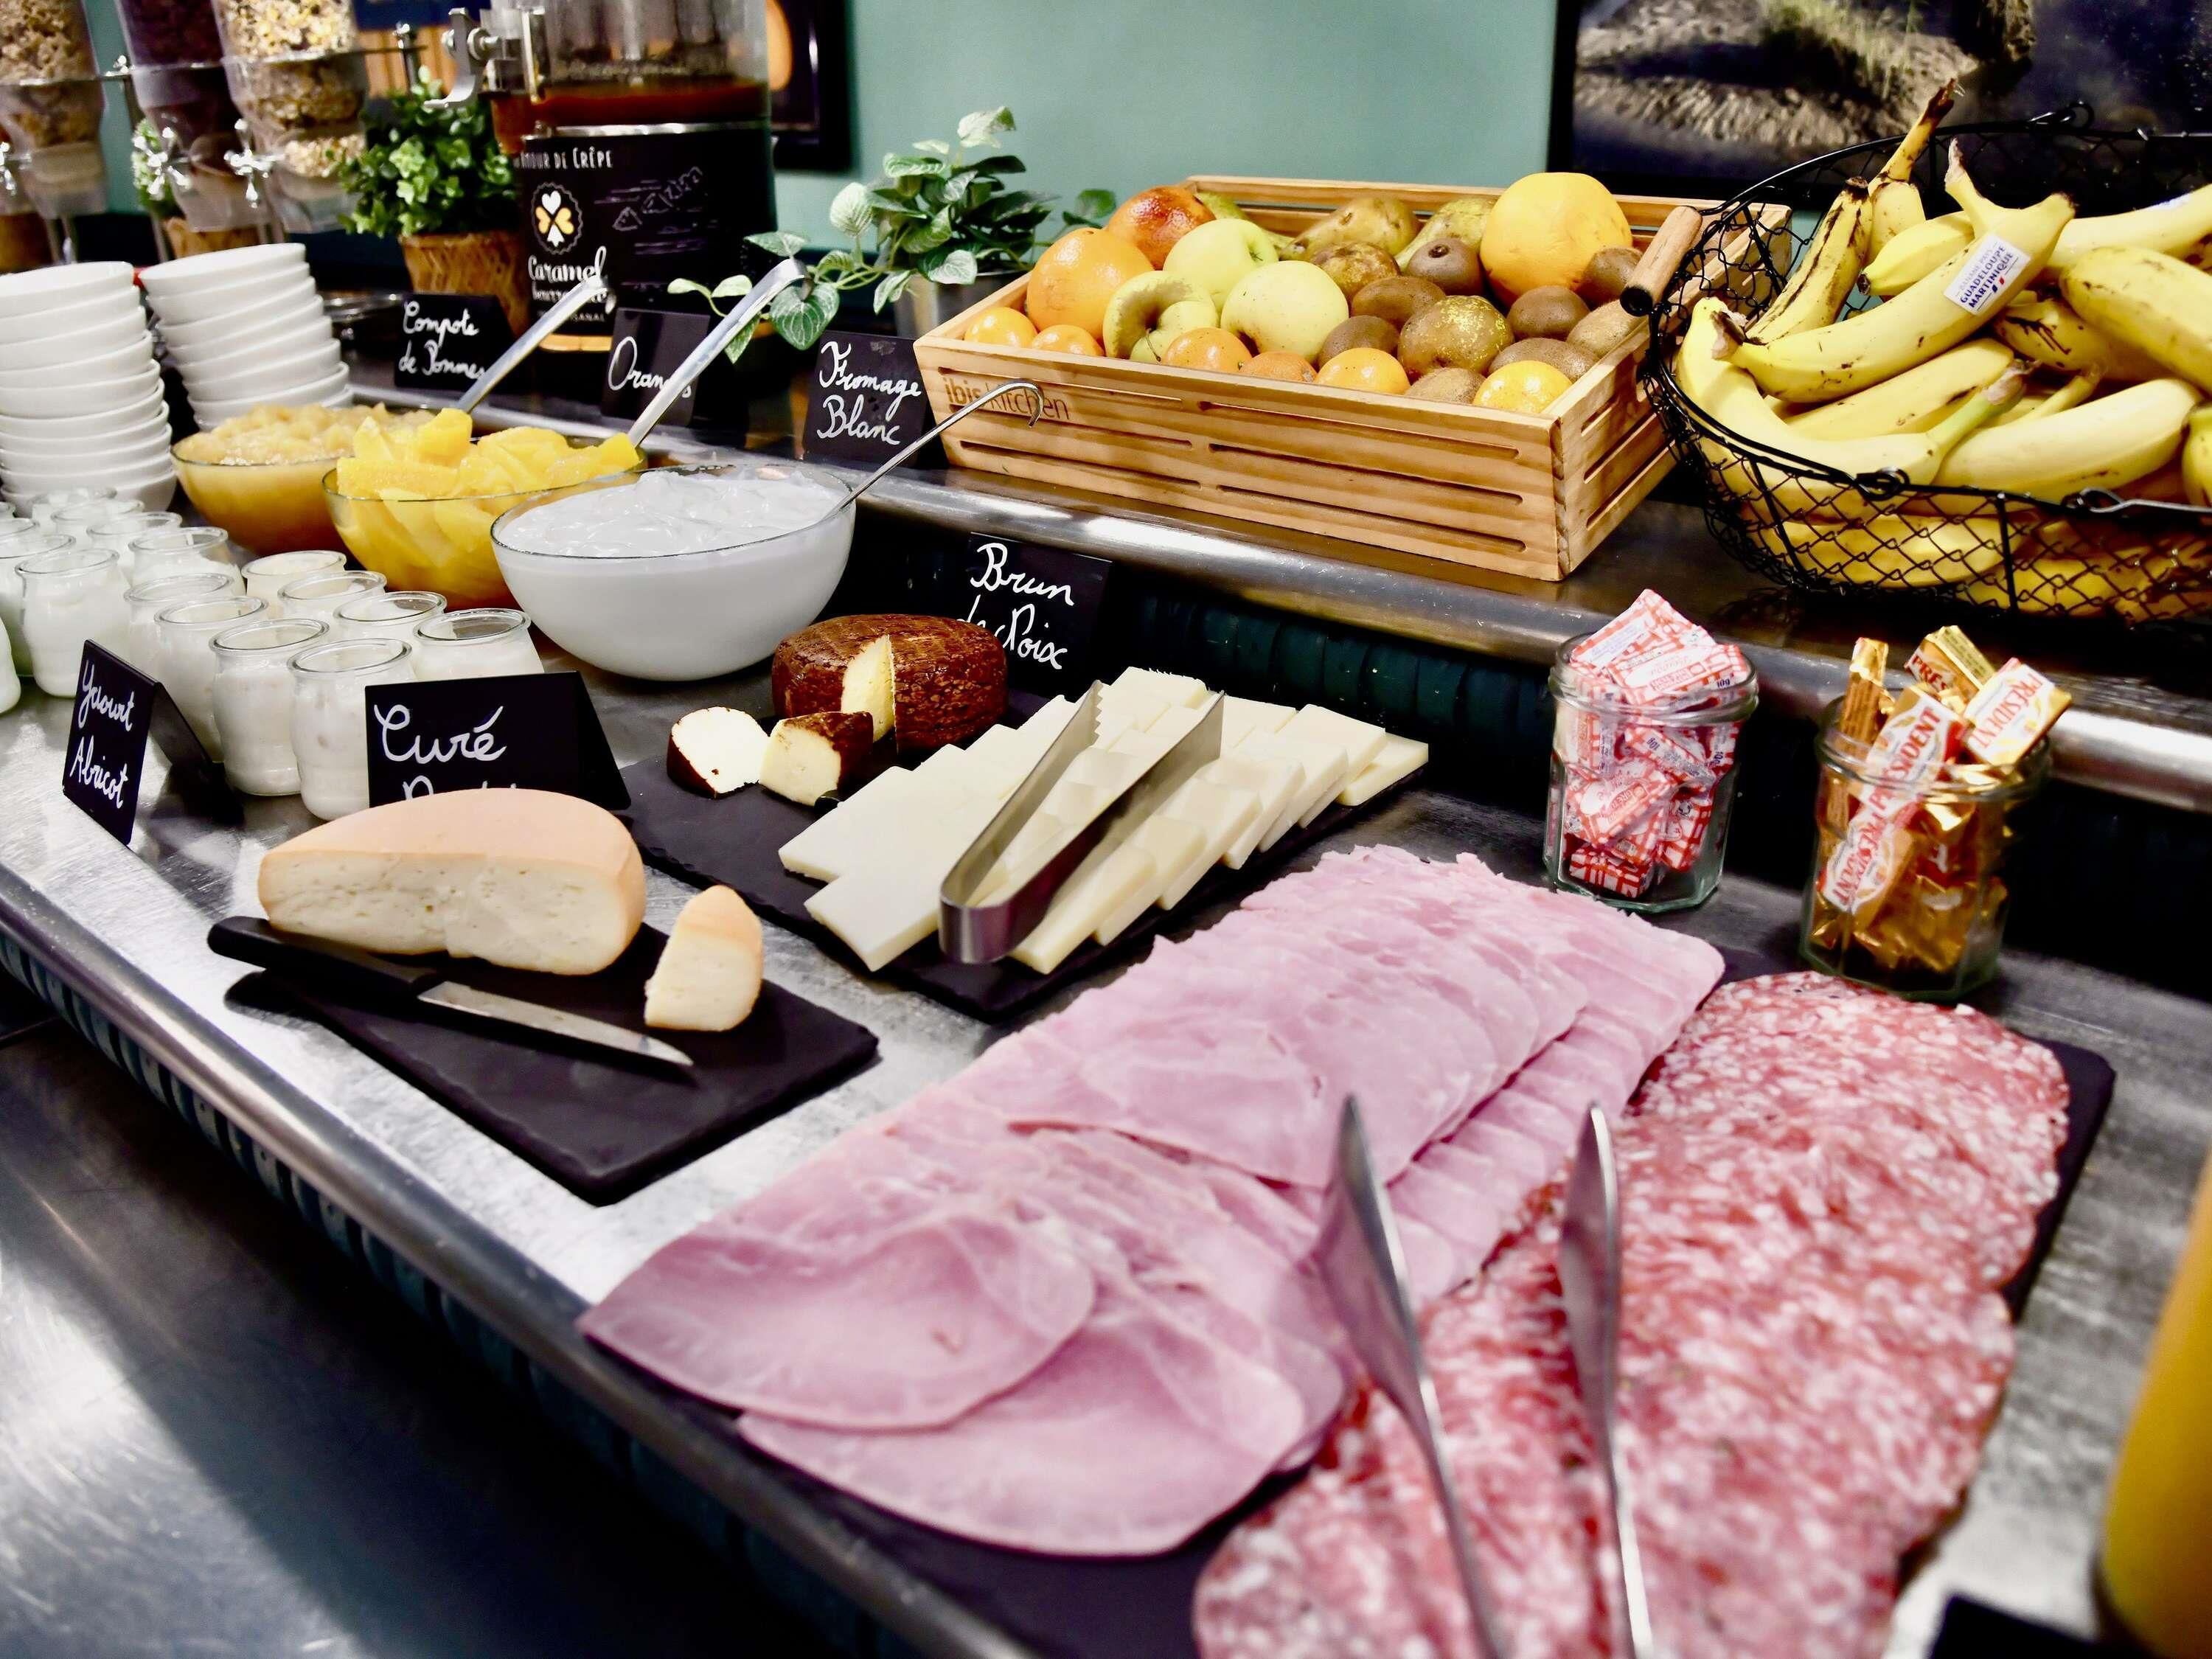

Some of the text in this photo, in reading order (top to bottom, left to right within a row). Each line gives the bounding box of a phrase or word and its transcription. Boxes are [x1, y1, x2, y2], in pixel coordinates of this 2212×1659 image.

[528, 246, 607, 284] Caramel
[1961, 245, 2006, 303] GUADELOUPE
[1969, 252, 2013, 308] MARTINIQUE
[403, 300, 479, 348] Compote
[398, 339, 417, 374] de
[608, 335, 692, 398] Orans
[819, 341, 922, 422] Fromage
[816, 394, 900, 445] Blanc
[970, 543, 1074, 606] Brun
[78, 660, 134, 731] Yaourt
[374, 704, 507, 764] Curé
[70, 735, 128, 809] Abricot
